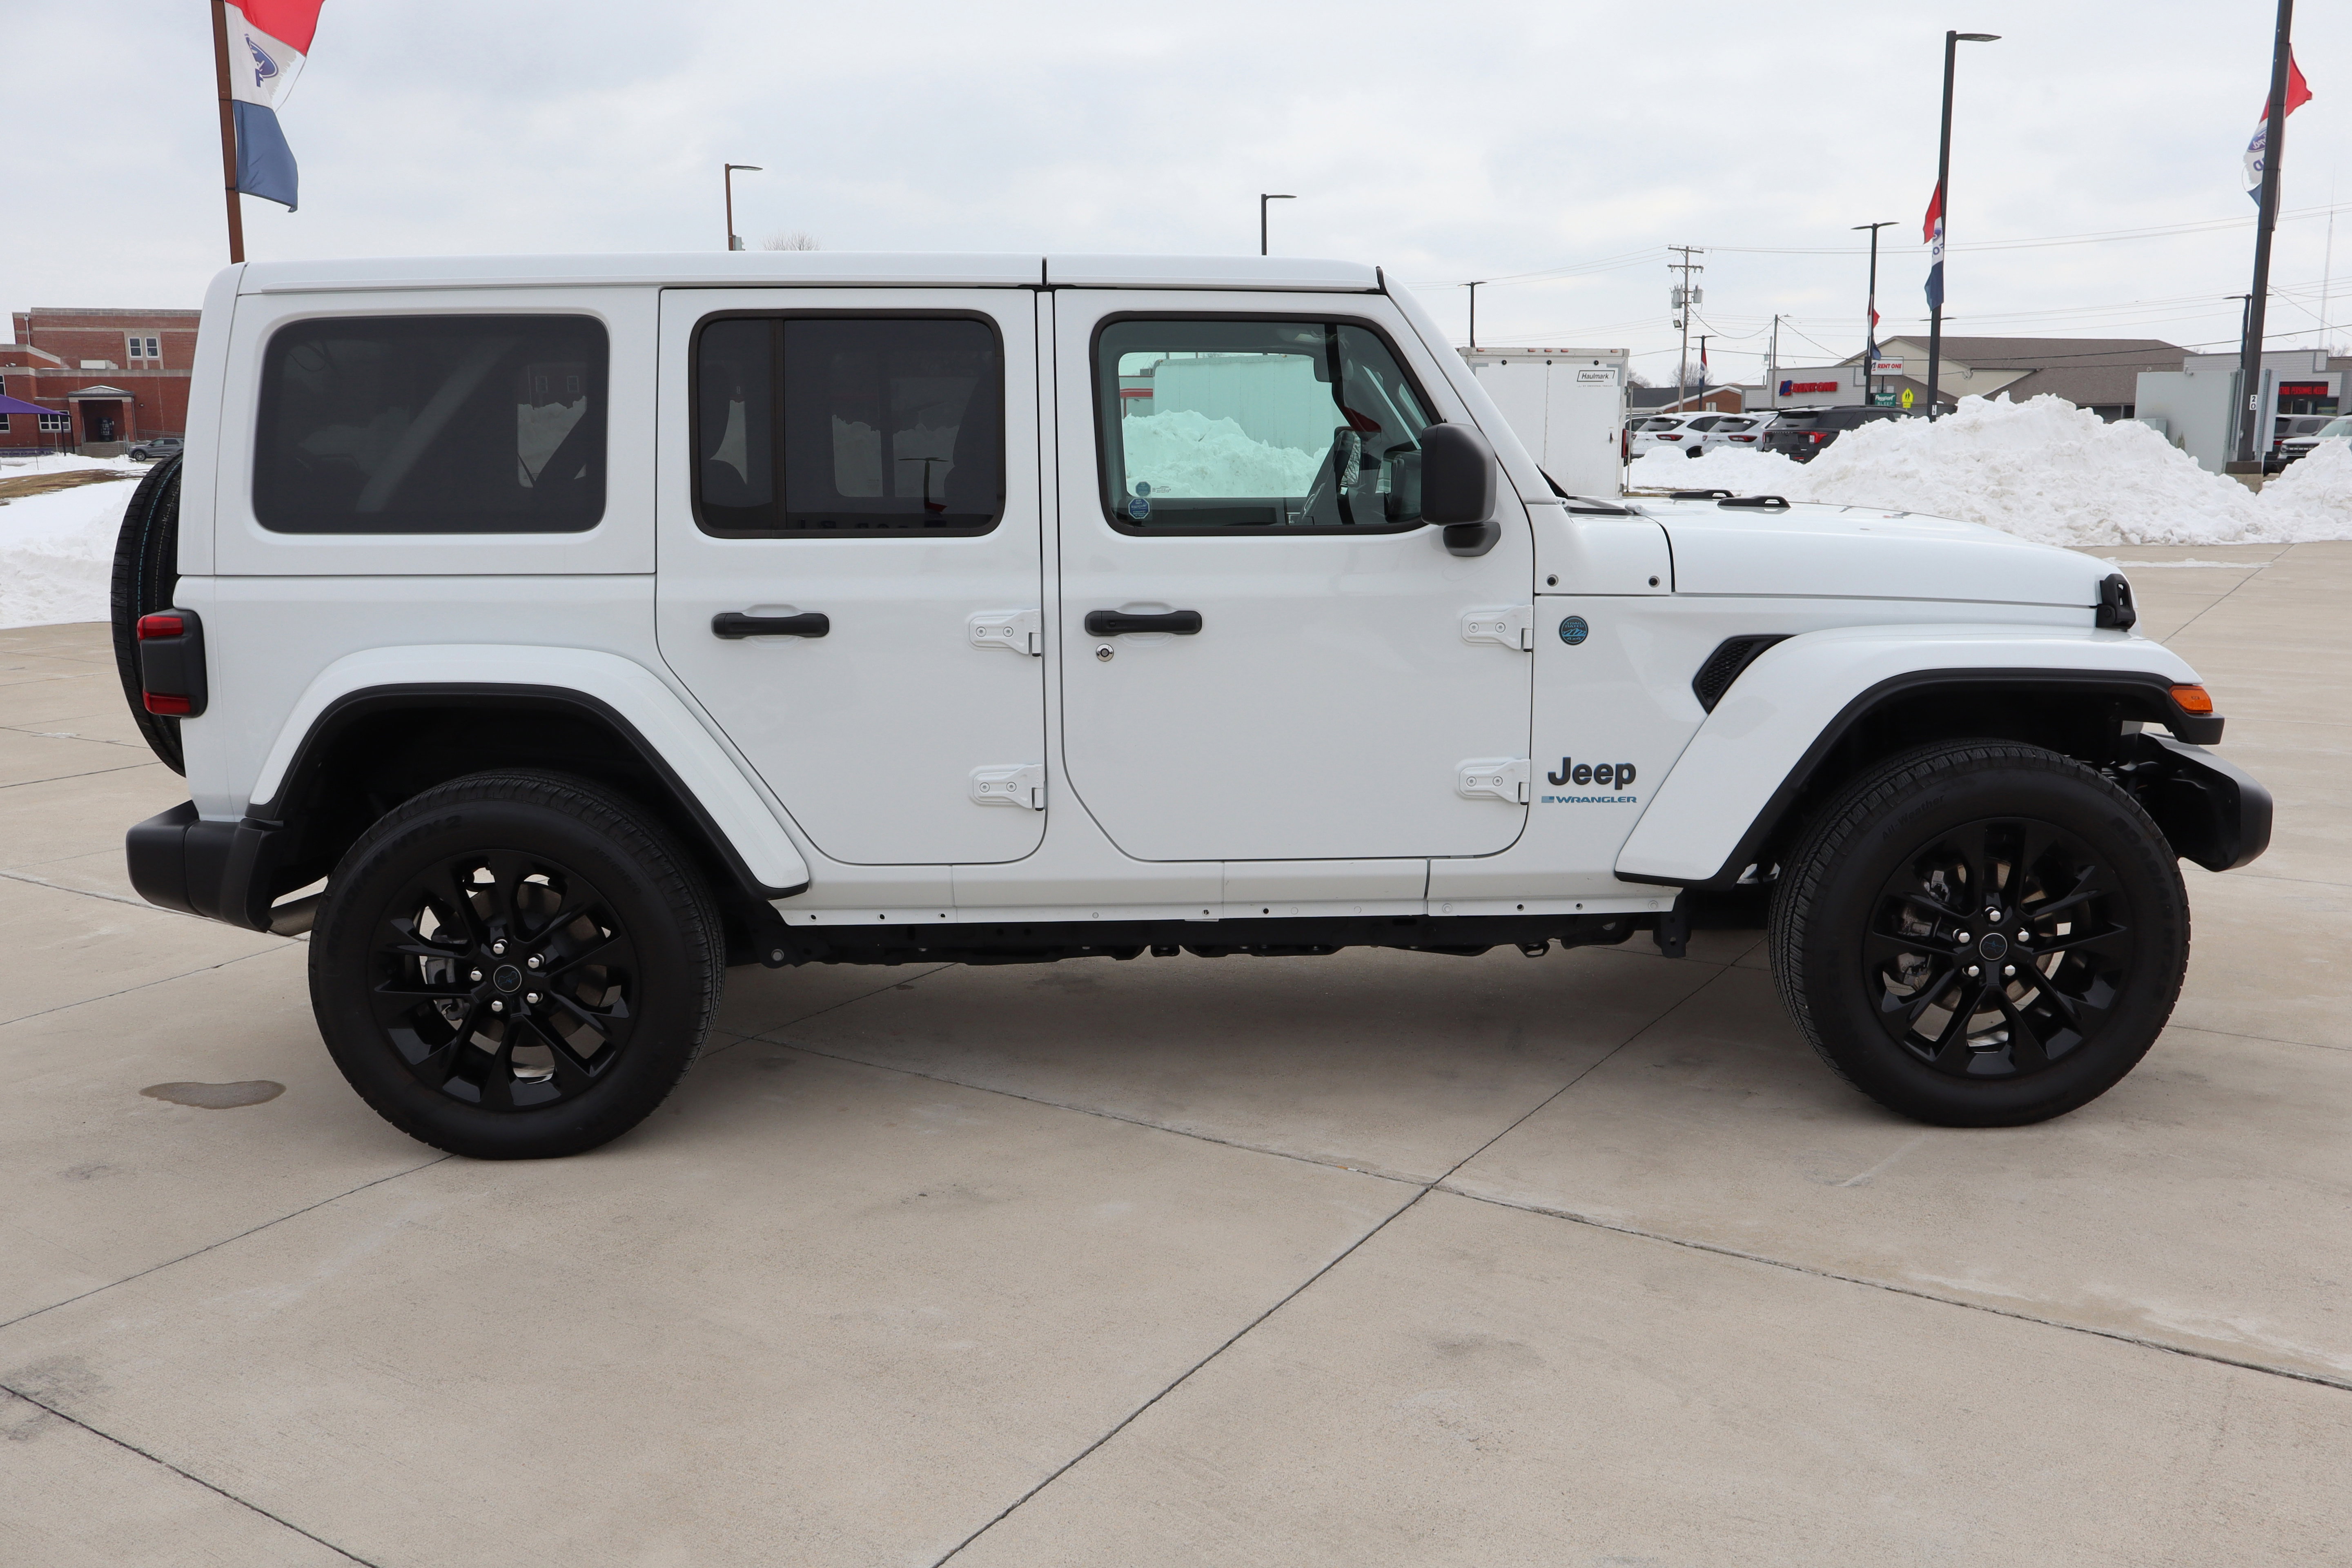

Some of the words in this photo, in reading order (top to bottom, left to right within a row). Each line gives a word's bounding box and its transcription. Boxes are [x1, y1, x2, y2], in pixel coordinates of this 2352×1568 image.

[1793, 383, 1817, 392] RENT
[1817, 382, 1838, 392] ONE
[1548, 757, 1636, 790] Jeep
